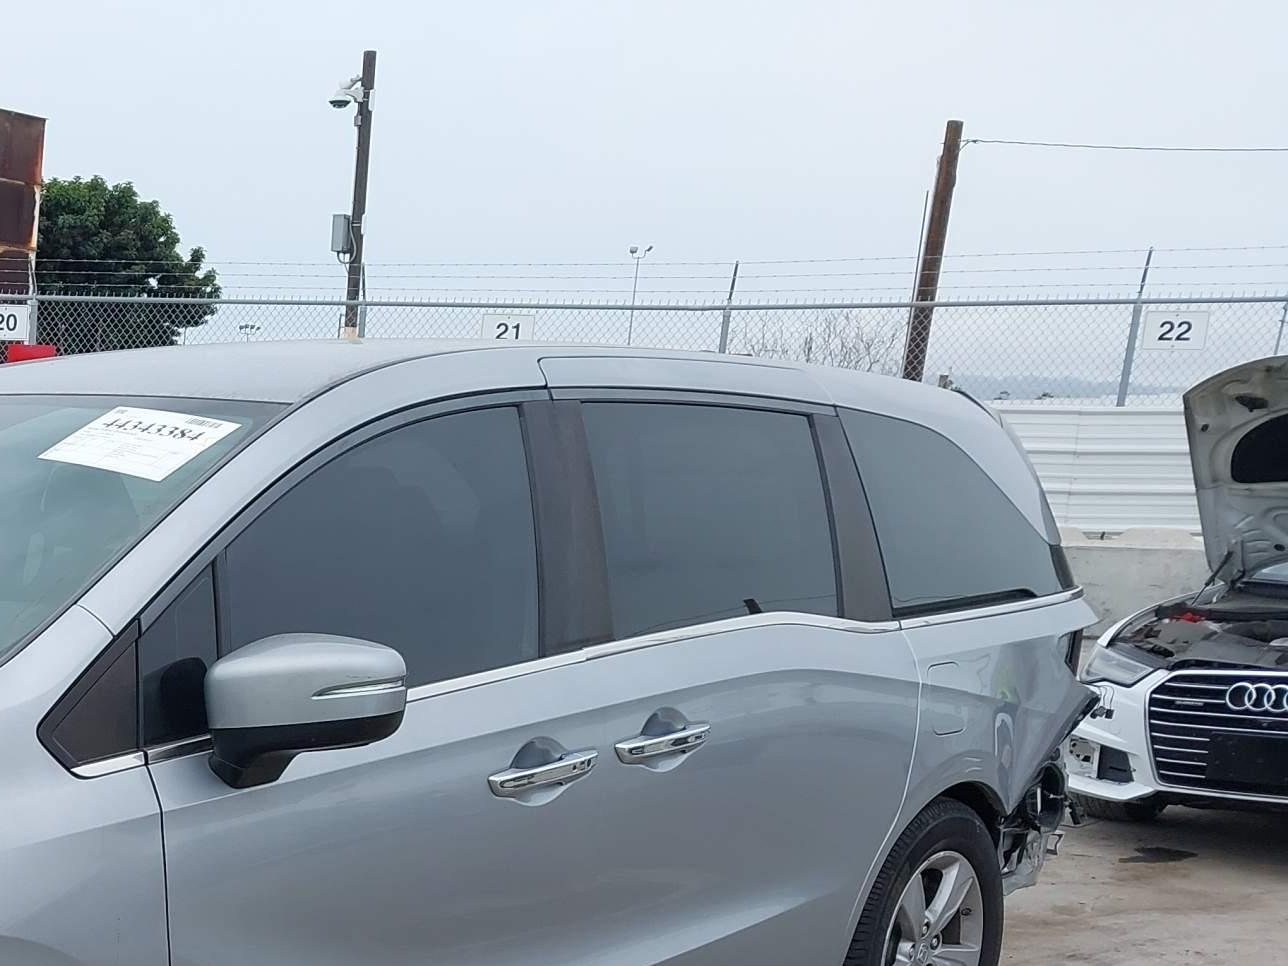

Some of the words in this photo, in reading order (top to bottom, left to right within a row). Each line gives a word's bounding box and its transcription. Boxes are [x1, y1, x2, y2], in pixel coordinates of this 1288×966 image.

[495, 322, 521, 340] 21
[1157, 320, 1193, 341] 22
[102, 417, 206, 441] 44343384
